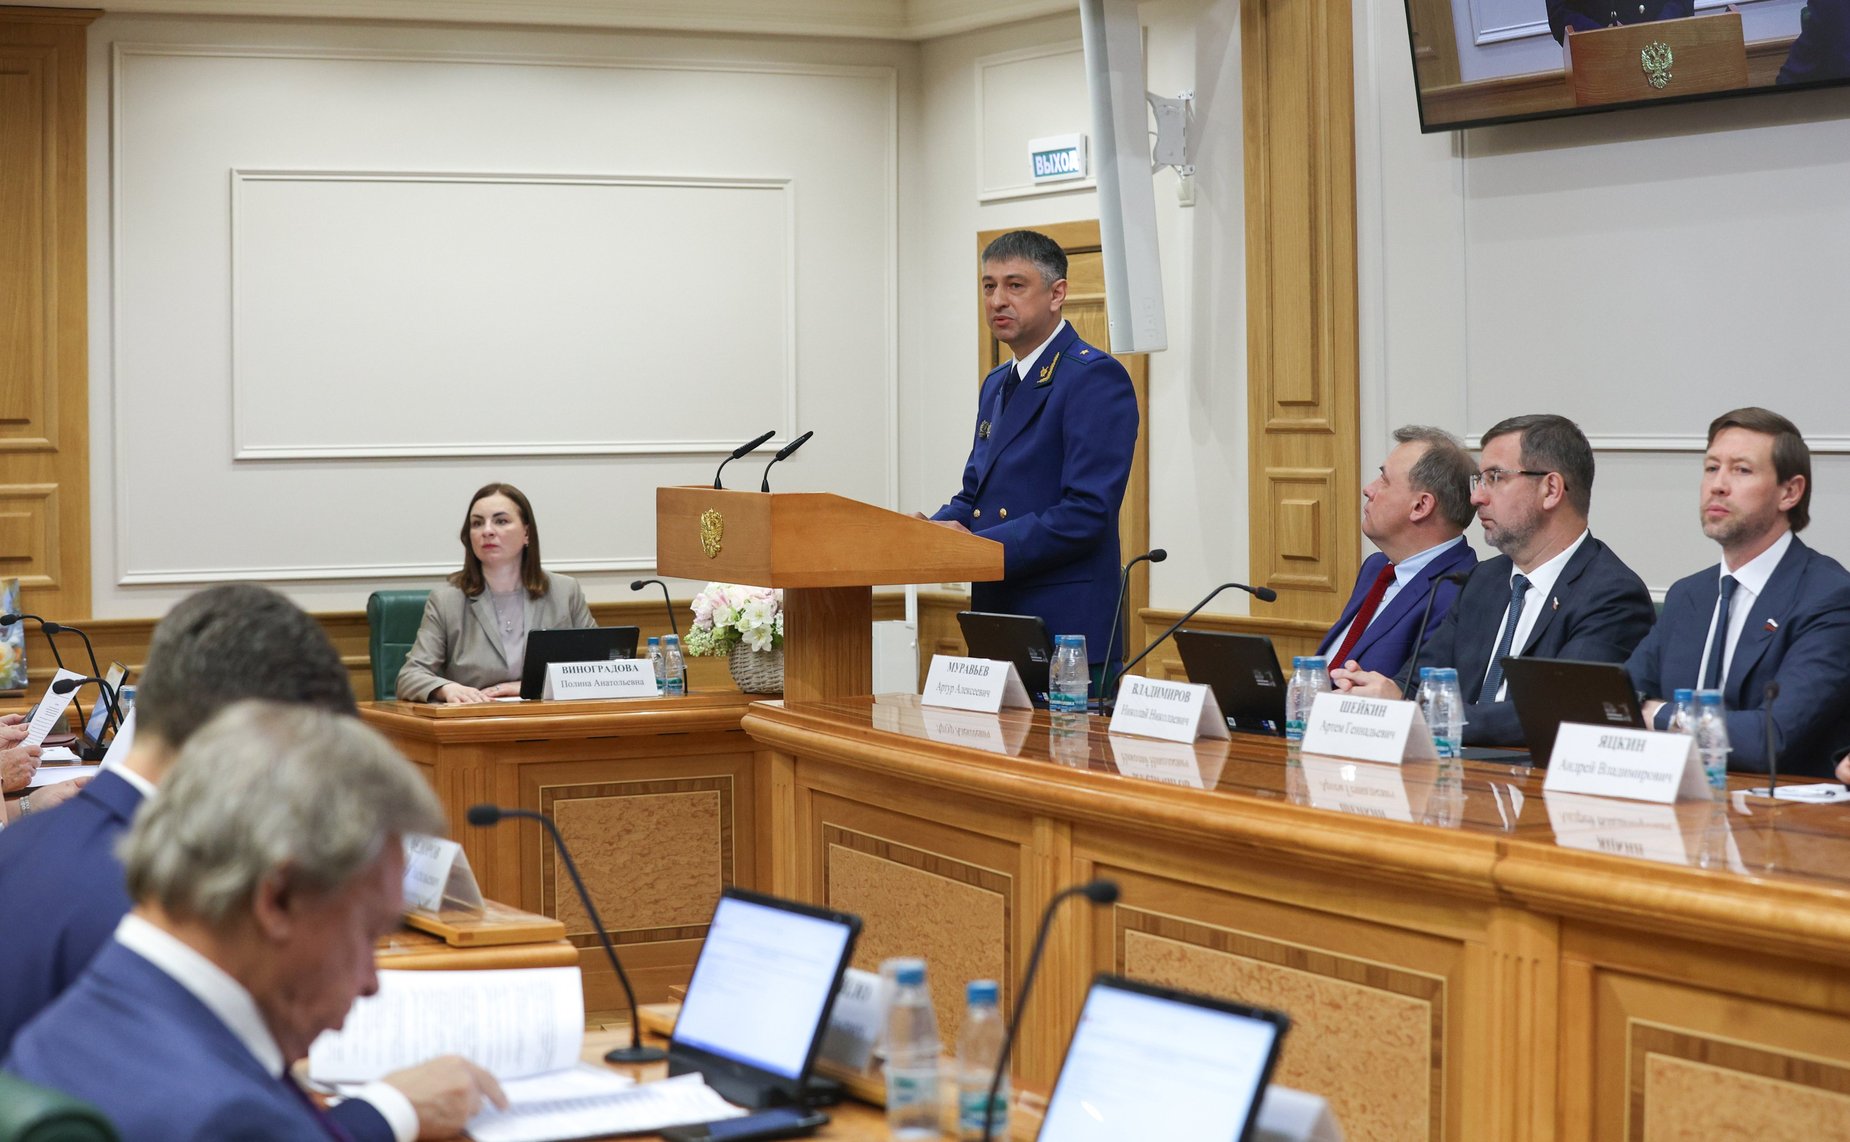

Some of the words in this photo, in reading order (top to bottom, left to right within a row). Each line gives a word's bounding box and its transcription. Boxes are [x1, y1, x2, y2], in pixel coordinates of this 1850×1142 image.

[562, 664, 639, 674] ВИНОГРАДОВА
[947, 661, 990, 677] МУРАВЬЕВ
[560, 679, 592, 688] Полина
[593, 678, 645, 688] Анатольевна
[936, 681, 955, 698] Артур
[955, 683, 991, 698] Алексеевич
[1131, 682, 1192, 703] ВЛАДИМИРОВ
[1339, 699, 1388, 718] ШЕЙКИН
[1597, 734, 1647, 752] ЯЦКИН
[1558, 758, 1596, 776] Андрей
[1596, 761, 1674, 784] Владимирович
